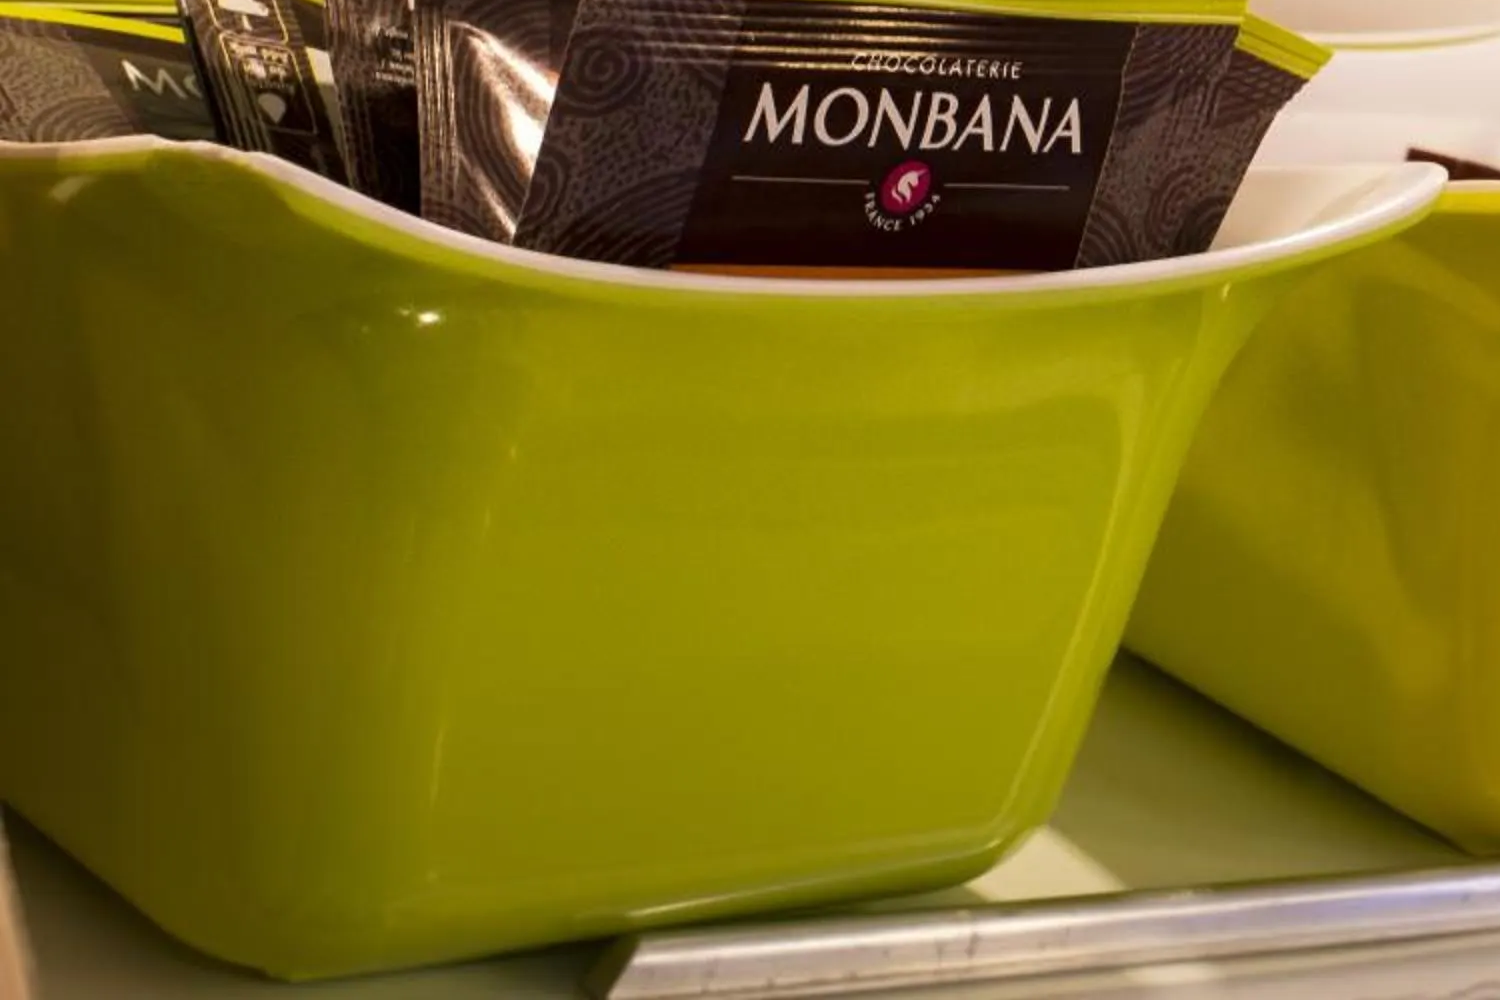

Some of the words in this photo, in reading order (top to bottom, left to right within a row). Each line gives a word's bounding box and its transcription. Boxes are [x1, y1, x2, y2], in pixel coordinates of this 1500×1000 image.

[851, 52, 1023, 79] CHOCOLATERIE
[743, 81, 1083, 155] MONBANA
[864, 192, 902, 232] FRANCE
